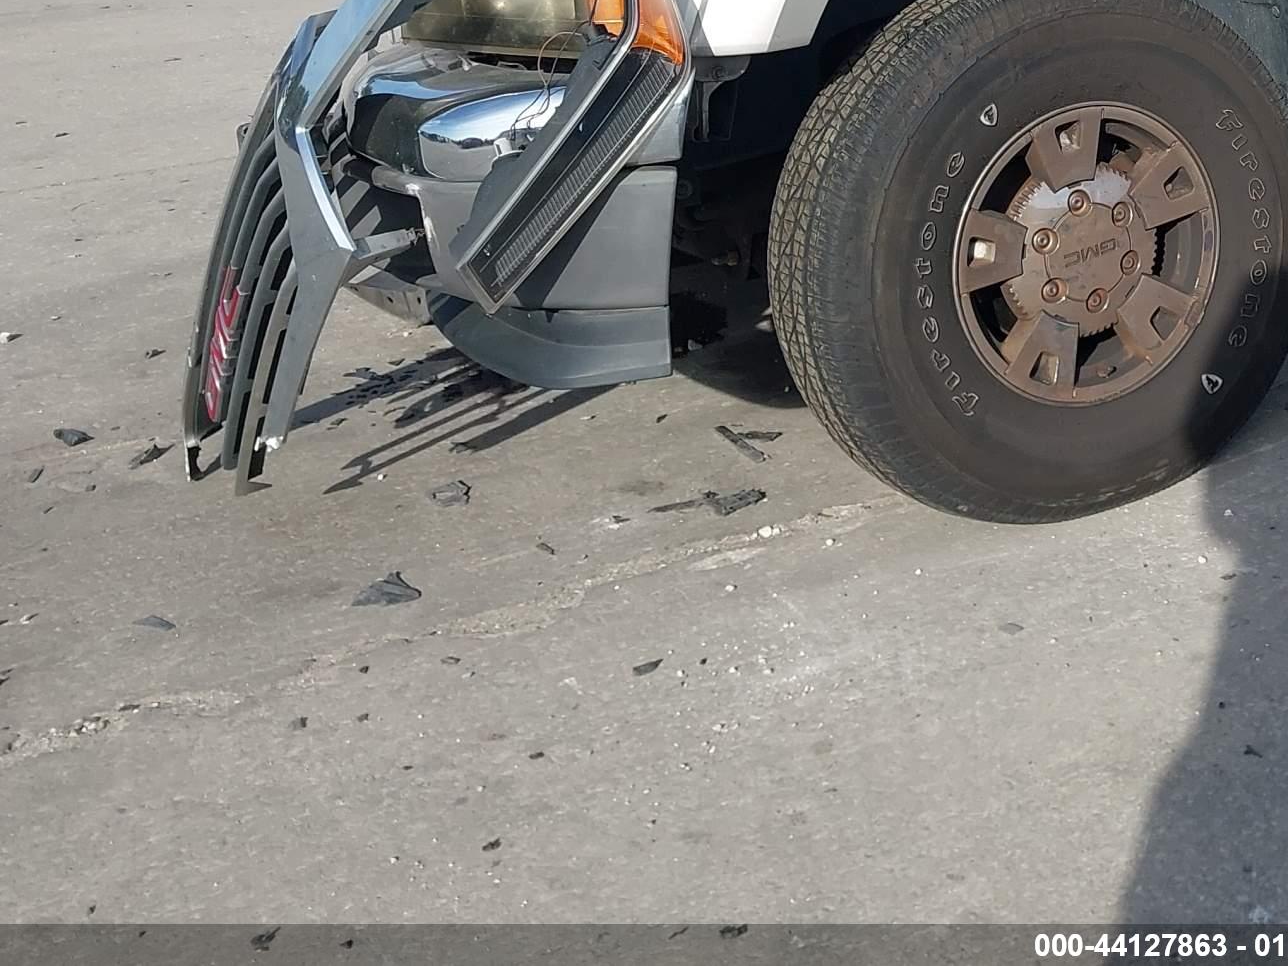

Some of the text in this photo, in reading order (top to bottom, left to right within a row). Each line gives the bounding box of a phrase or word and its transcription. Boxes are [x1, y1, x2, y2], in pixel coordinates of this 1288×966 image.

[915, 151, 979, 417] Firestone
[1063, 239, 1118, 269] GMC
[1216, 109, 1272, 348] Firestone
